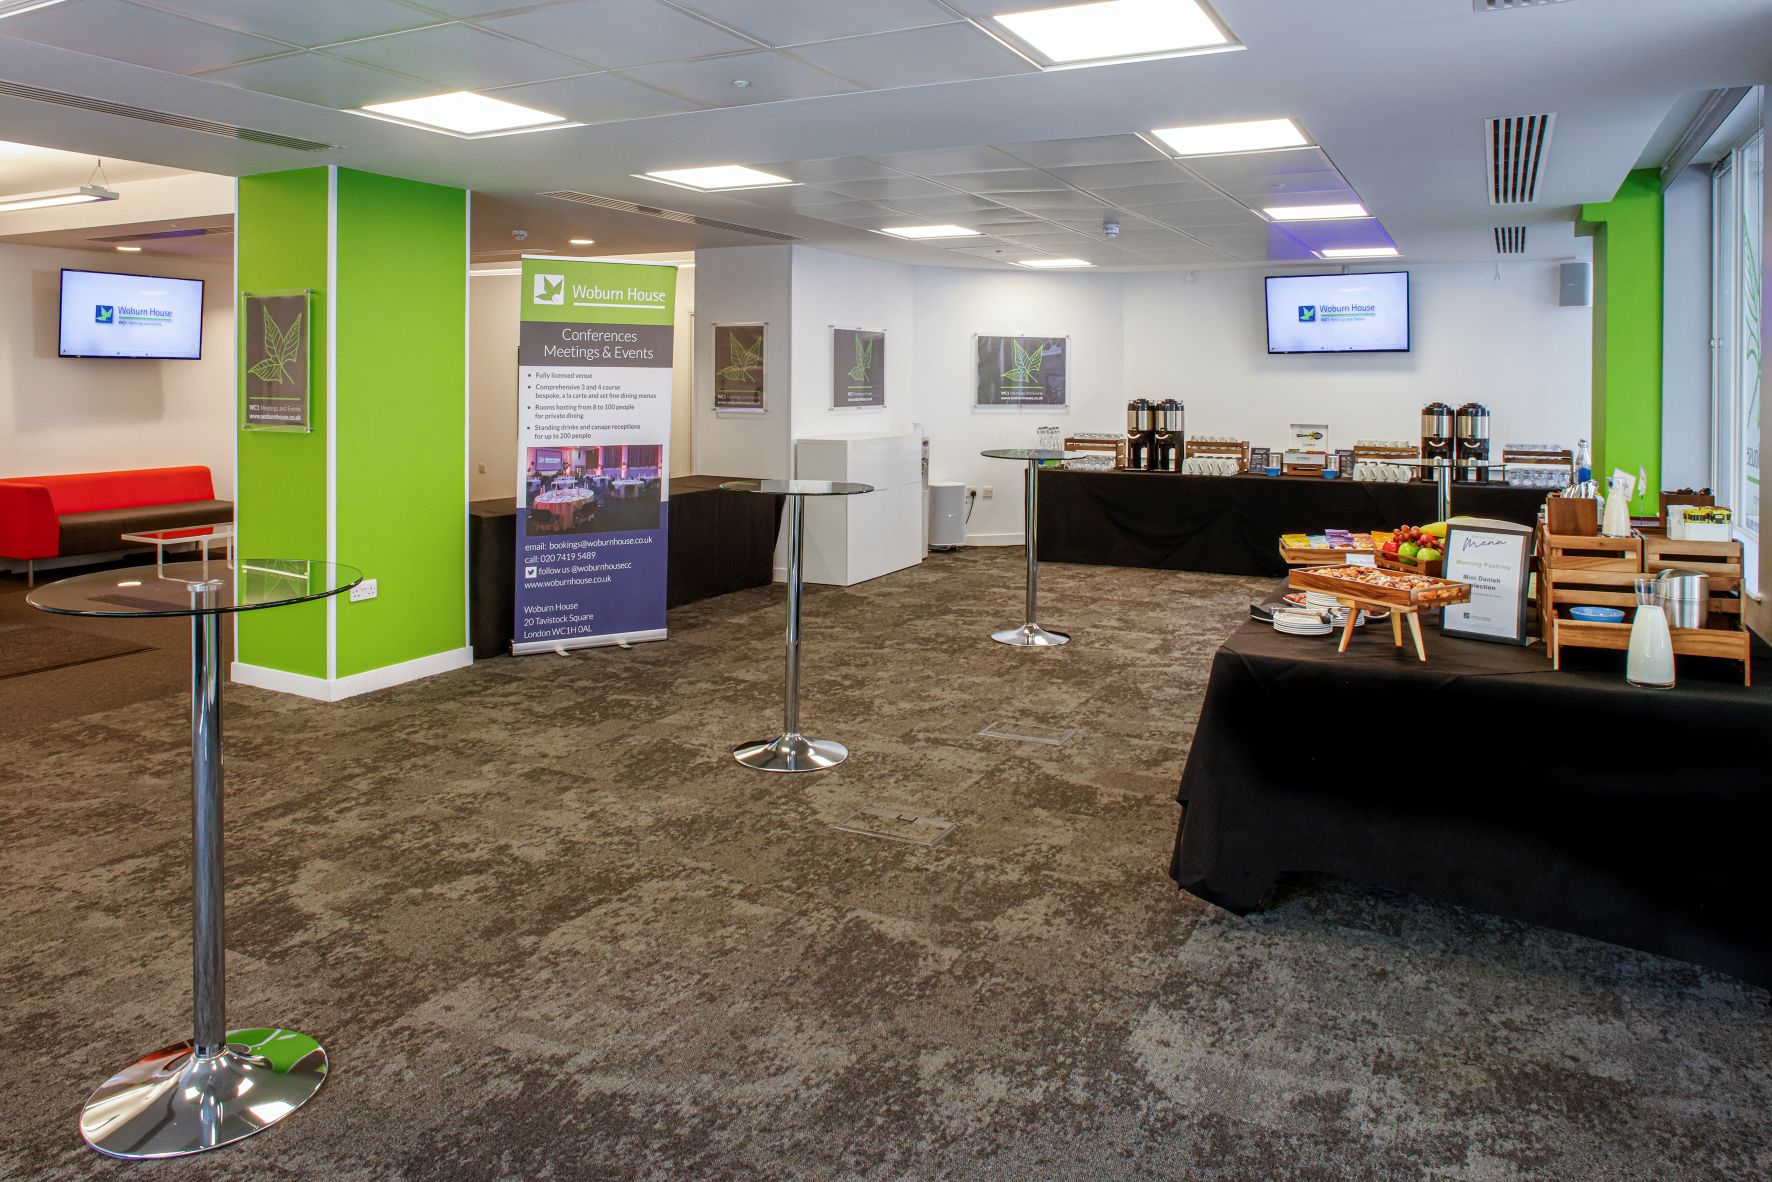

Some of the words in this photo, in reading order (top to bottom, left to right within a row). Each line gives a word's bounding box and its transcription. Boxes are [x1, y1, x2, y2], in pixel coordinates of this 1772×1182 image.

[573, 285, 623, 300] Woburn
[627, 288, 666, 302] House
[118, 306, 148, 316] Woburn
[150, 308, 172, 317] House
[562, 328, 637, 342] Conferences
[544, 345, 600, 360] Meetings
[602, 346, 611, 358] &
[614, 346, 654, 359] Events
[525, 542, 547, 551] email:
[549, 536, 653, 550] bookings@woburnhouse.co.uk
[524, 555, 539, 564] call:
[540, 555, 555, 563] 020
[557, 553, 575, 561] 7419
[577, 551, 596, 560] 5489
[1456, 559, 1482, 569] Morning
[538, 567, 563, 575] follow
[571, 562, 632, 573] @woburnhousecc
[524, 575, 612, 589] www.woburnhouse.co.uk
[1478, 575, 1501, 584] Danish
[1471, 583, 1496, 591] election
[524, 605, 554, 614] Woburn
[555, 603, 579, 611] House
[524, 618, 534, 626] 20
[535, 615, 568, 625] Tavistock
[569, 613, 594, 622] Square
[524, 629, 550, 639] London
[551, 626, 577, 635] WC1H
